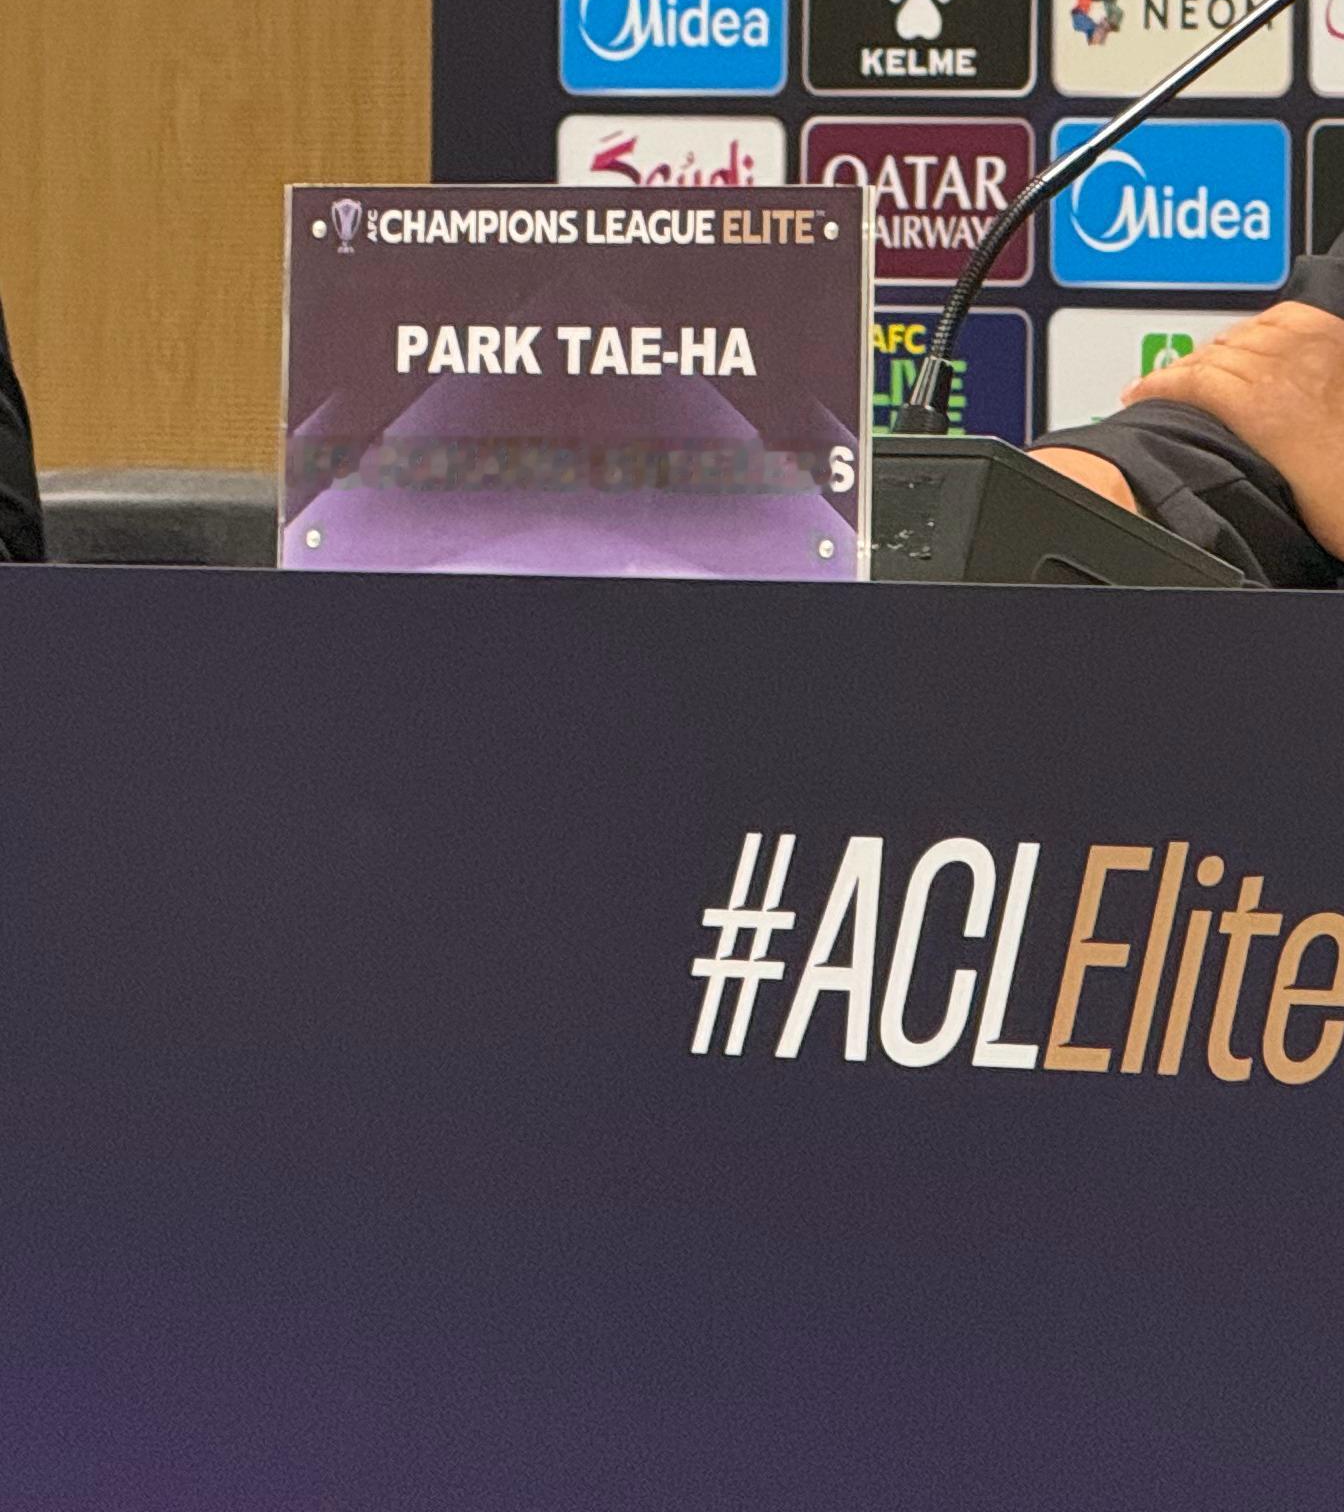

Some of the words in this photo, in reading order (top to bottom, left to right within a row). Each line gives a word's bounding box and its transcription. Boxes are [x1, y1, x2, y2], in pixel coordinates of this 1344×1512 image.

[861, 49, 976, 77] KELME
[367, 209, 379, 243] AFC
[379, 209, 579, 245] CHAMPIONS
[586, 210, 716, 245] LEAGUE
[723, 210, 816, 245] ELITE
[1099, 186, 1271, 240] Midea
[875, 215, 996, 249] AIRWAY
[396, 325, 543, 375] PARK
[557, 326, 757, 377] TAE-HA
